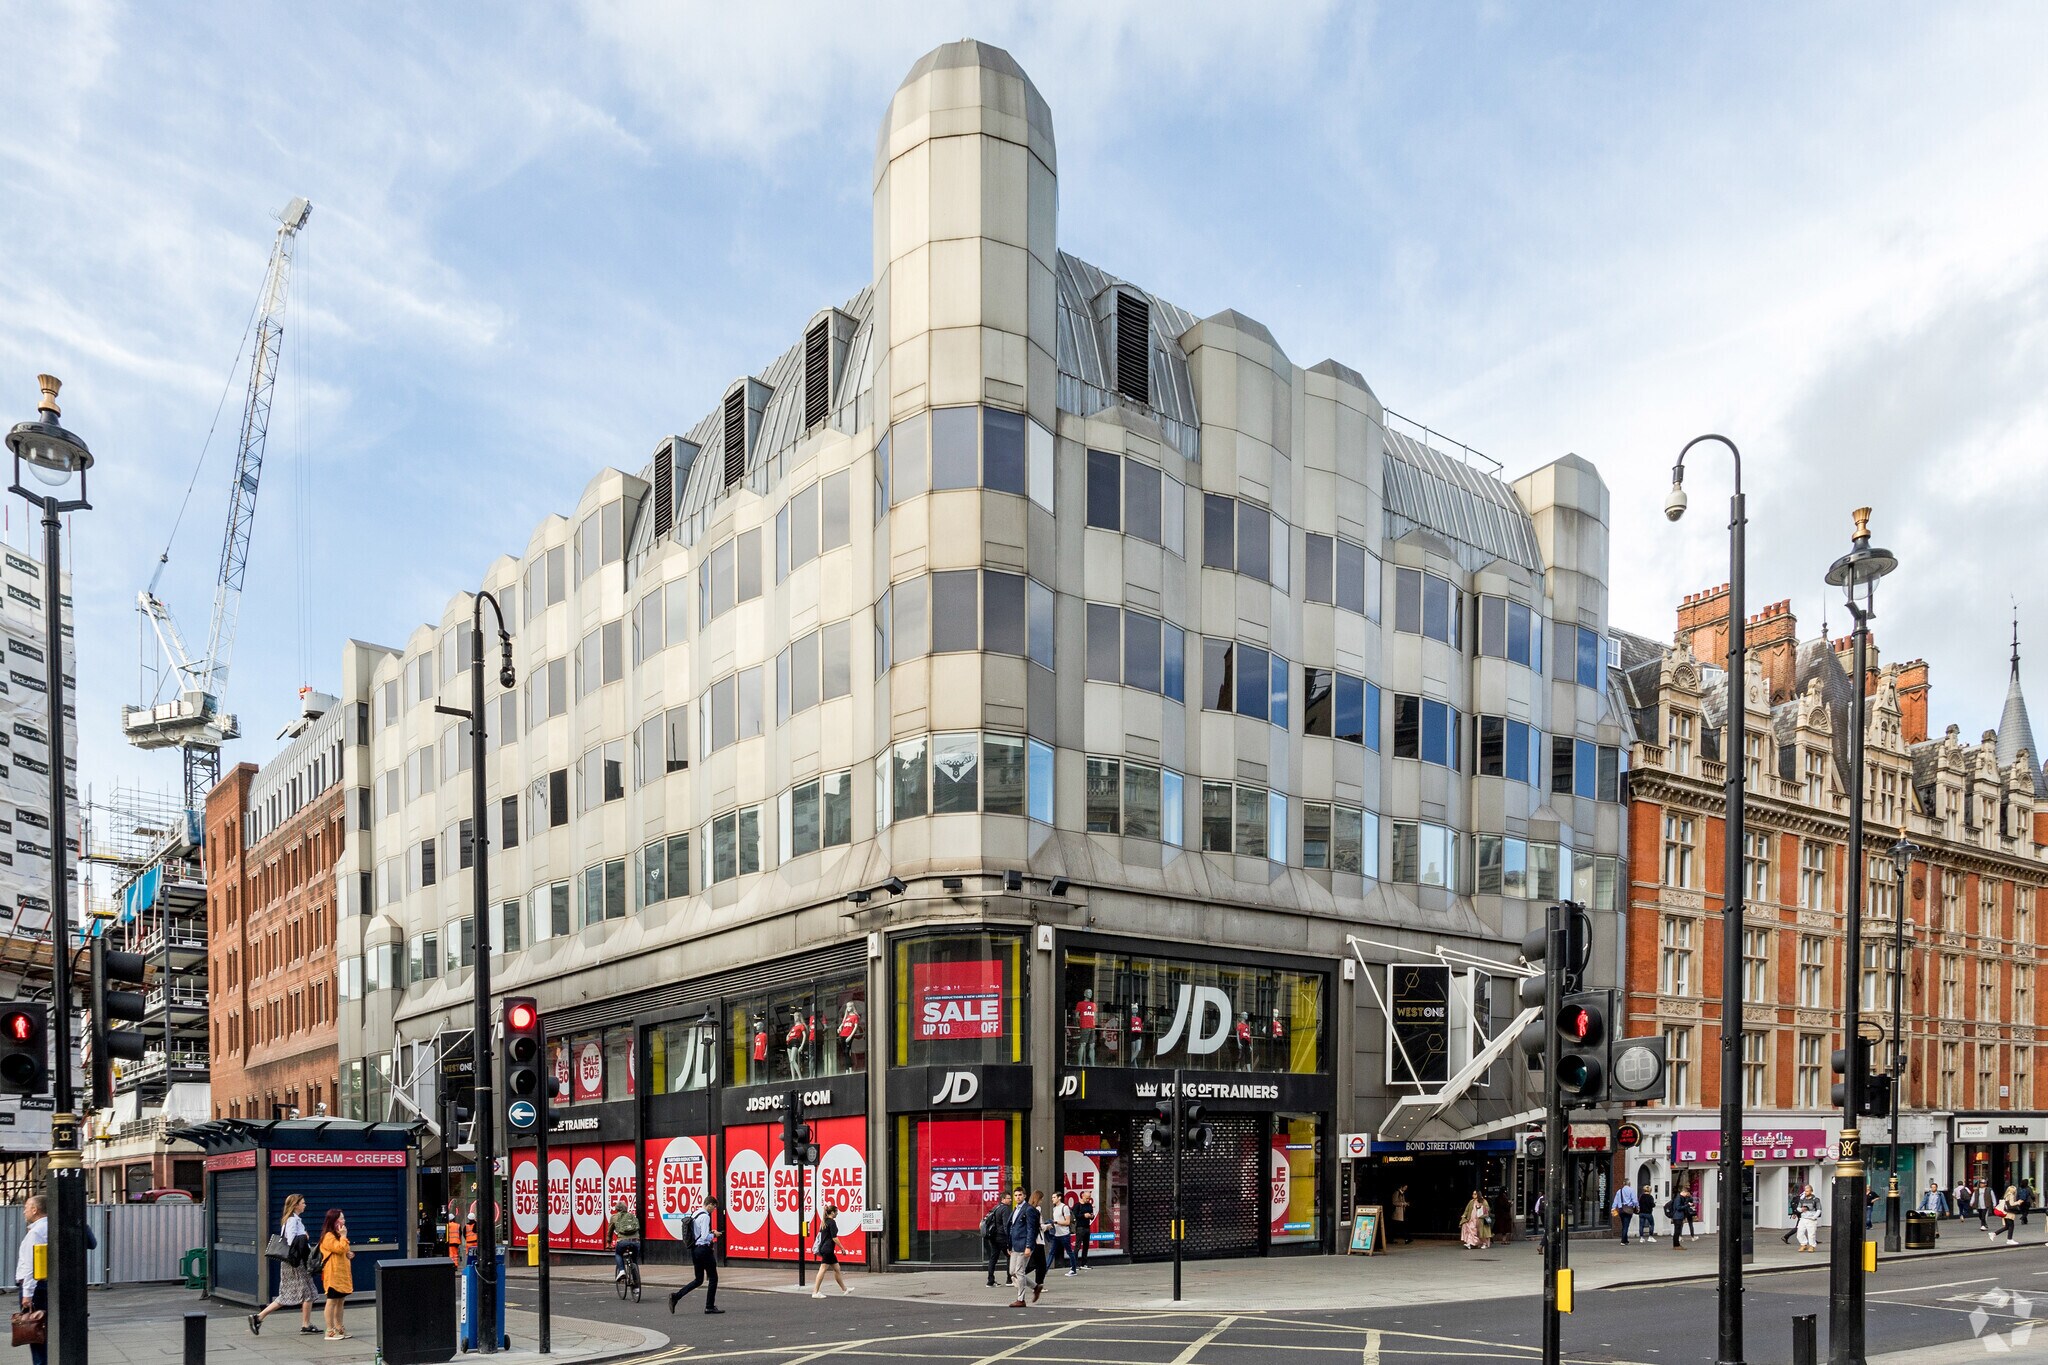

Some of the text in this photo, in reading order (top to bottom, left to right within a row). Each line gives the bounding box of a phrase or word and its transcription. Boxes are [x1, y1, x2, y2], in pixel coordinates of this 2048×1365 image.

[923, 1000, 998, 1023] SALE
[1157, 984, 1232, 1056] JD
[923, 1024, 936, 1036] UP
[938, 1023, 950, 1035] TO
[981, 1022, 998, 1034] OFF
[558, 1060, 569, 1071] SAL
[583, 1055, 599, 1067] SALE
[932, 1072, 978, 1105] JD
[1058, 1076, 1078, 1097] JD
[1212, 1084, 1279, 1099] TRAINERS
[22, 1100, 53, 1109] McLAREN
[565, 1118, 598, 1130] TRAINERS
[1406, 1141, 1475, 1150] BOND STREET STATION
[274, 1153, 296, 1163] ICE
[299, 1153, 343, 1163] CREAM
[355, 1153, 403, 1163] CREPES
[663, 1163, 702, 1185] SALE
[731, 1171, 765, 1188] SALE
[774, 1170, 812, 1187] SALE
[822, 1168, 862, 1187] SALE
[931, 1171, 999, 1191] SALE
[1063, 1172, 1094, 1190] ALE
[516, 1179, 538, 1194] SALE
[575, 1177, 602, 1194] SALE
[608, 1176, 636, 1194] SALE
[576, 1195, 602, 1215] 50%
[665, 1186, 702, 1214] 50%
[732, 1190, 765, 1212] 50%
[824, 1188, 862, 1213] 50%
[931, 1191, 999, 1203] UP TO OFF
